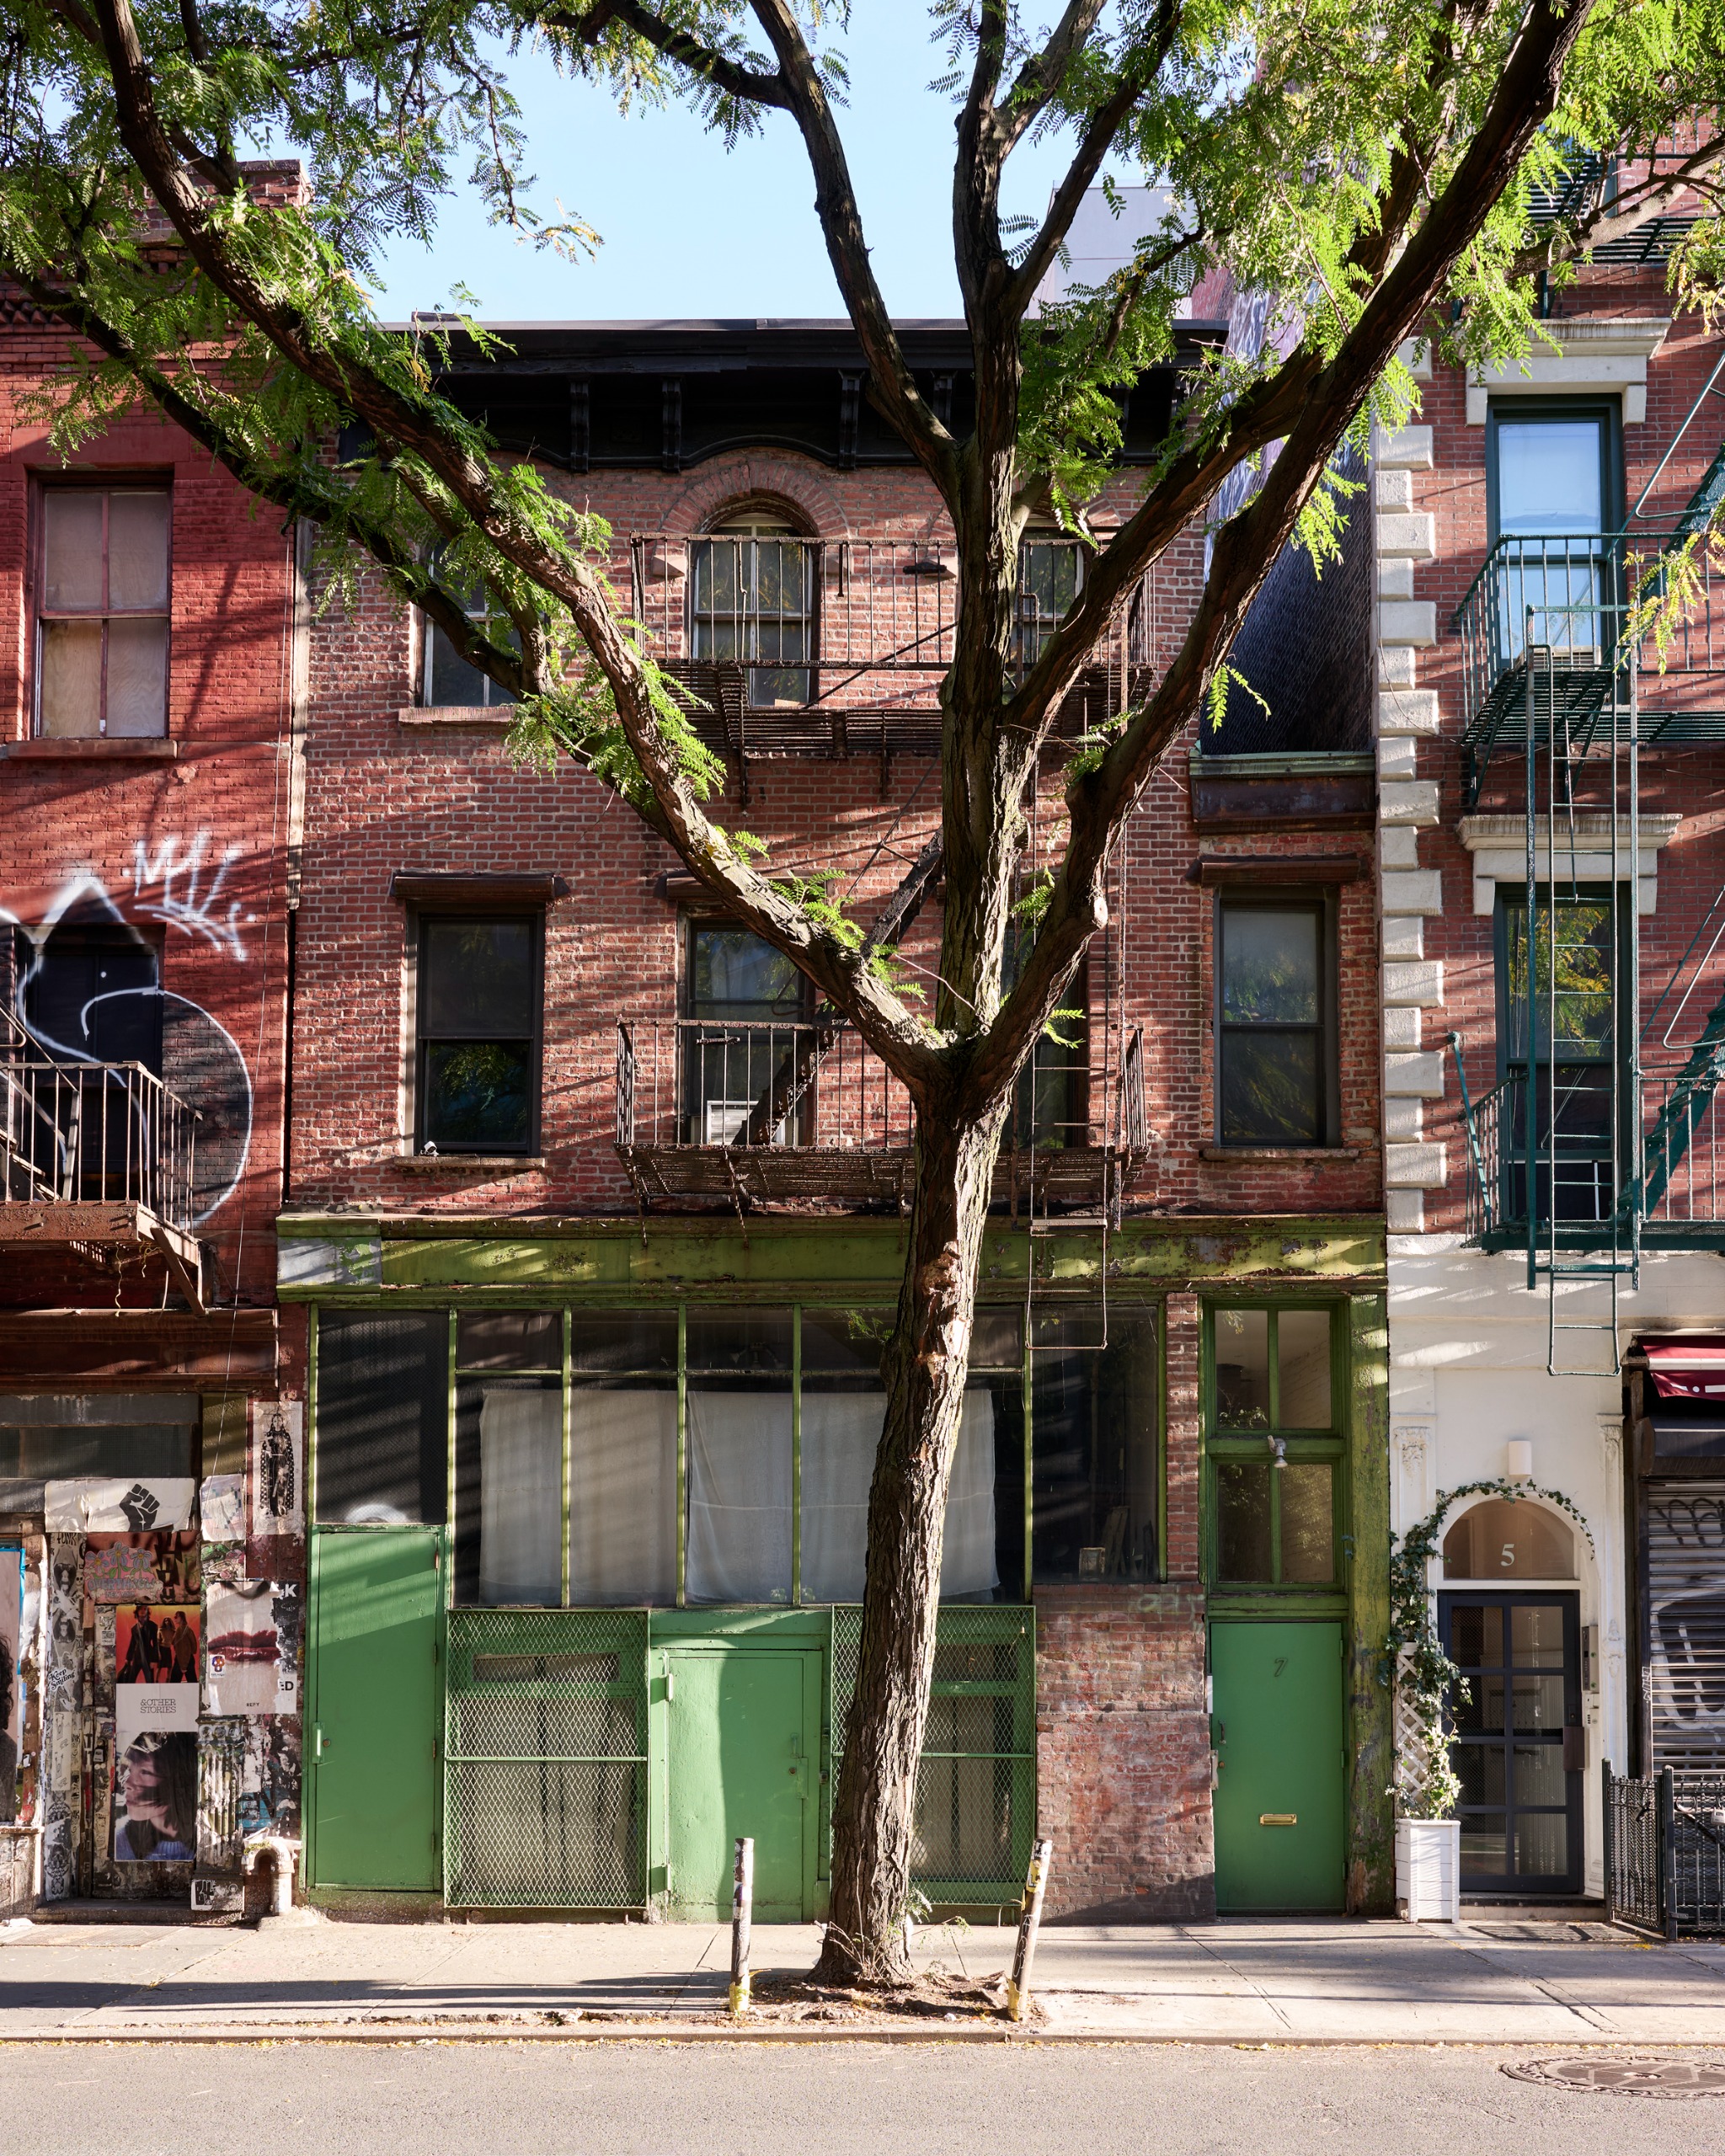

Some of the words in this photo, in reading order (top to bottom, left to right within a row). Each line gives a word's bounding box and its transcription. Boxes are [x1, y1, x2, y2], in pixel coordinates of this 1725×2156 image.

[1501, 1543, 1515, 1567] 5
[48, 1668, 67, 1681] Keep
[1274, 1657, 1288, 1677] 7
[51, 1670, 76, 1690] Smiling
[140, 1698, 176, 1706] &OTHER
